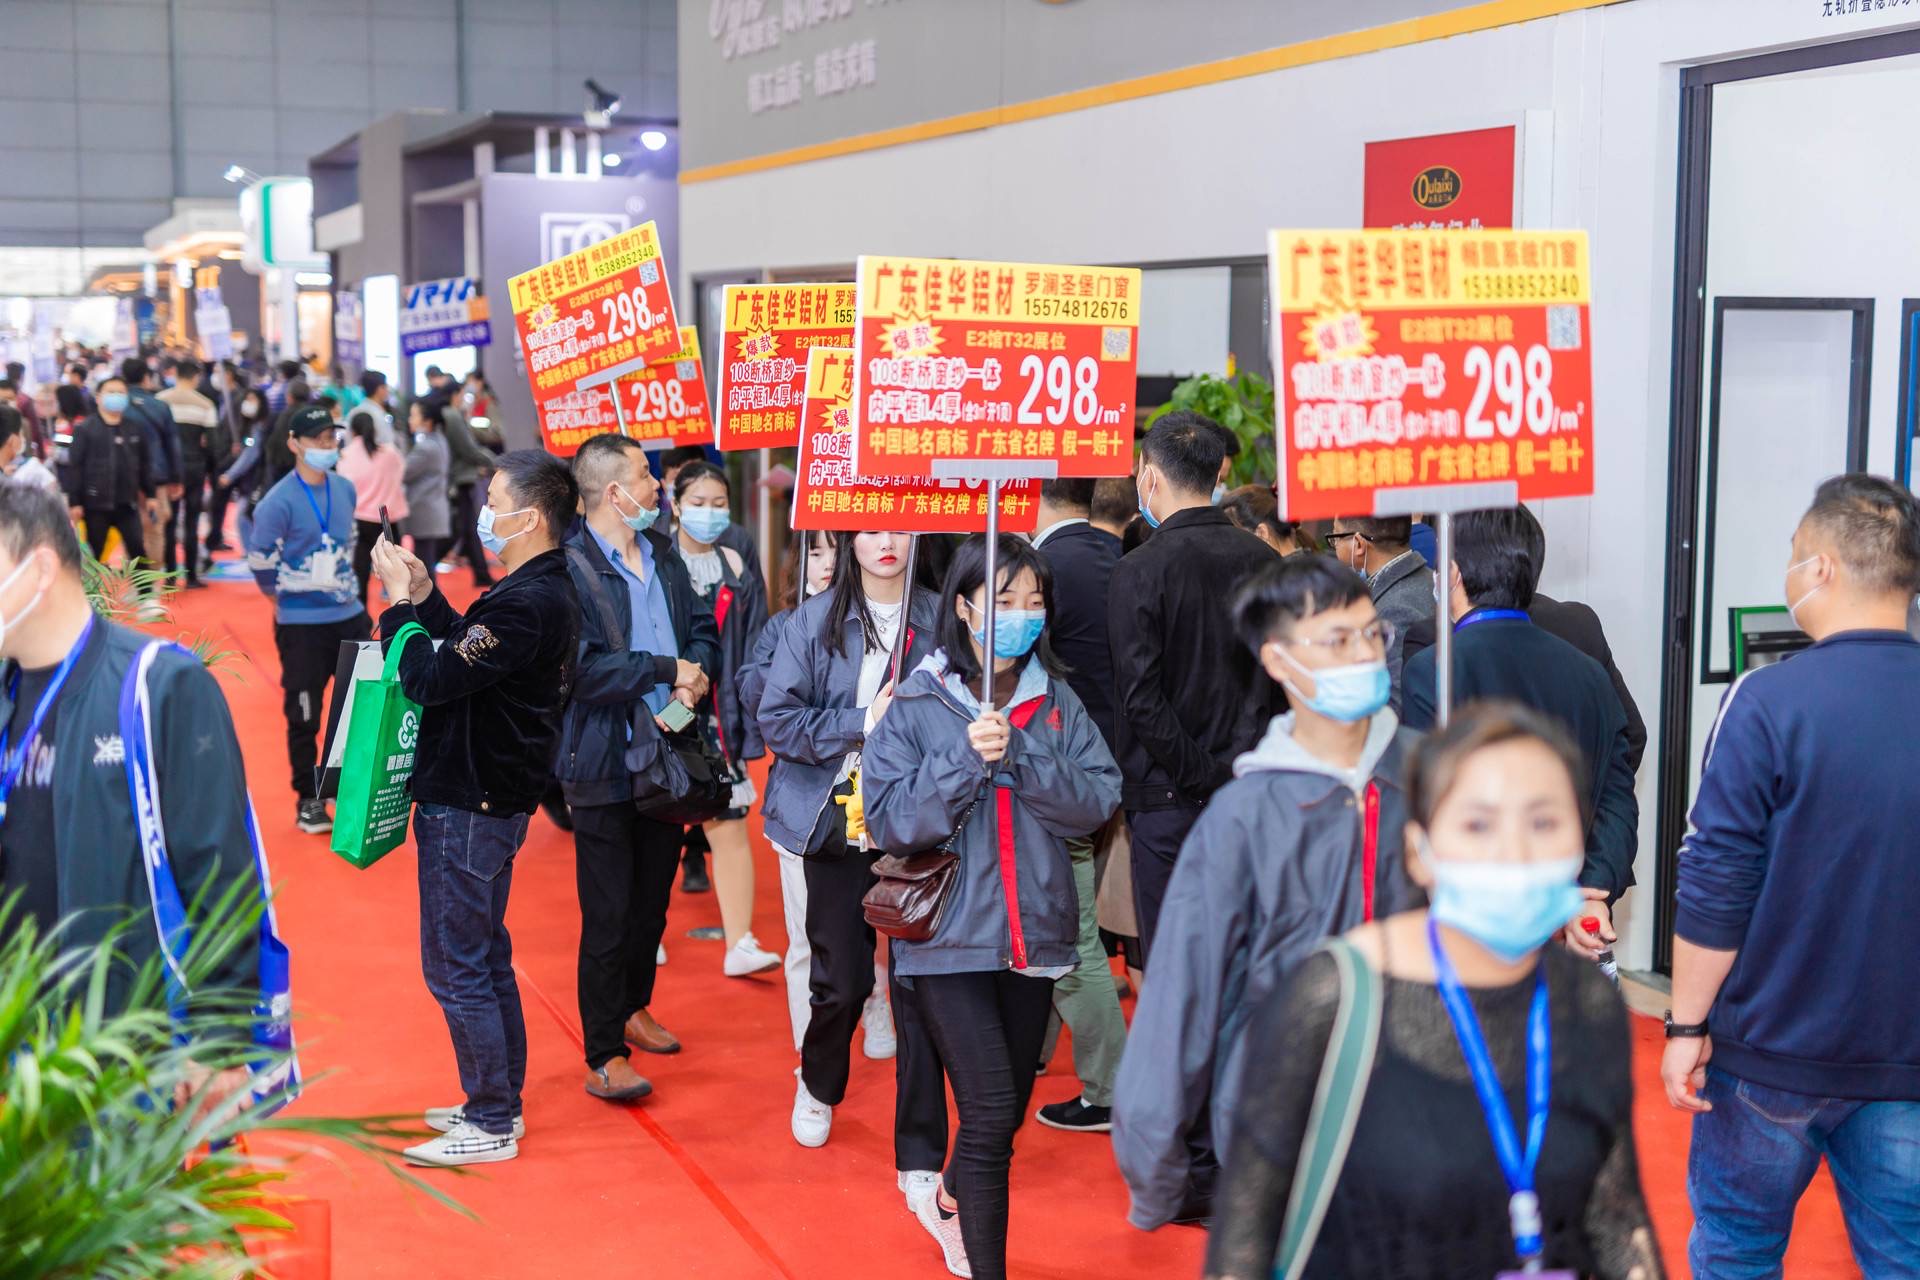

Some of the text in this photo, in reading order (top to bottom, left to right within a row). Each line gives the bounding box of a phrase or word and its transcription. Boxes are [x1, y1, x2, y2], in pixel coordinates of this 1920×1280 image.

[594, 245, 655, 277] 15388952340
[1291, 238, 1450, 300] 广东佳华铝材
[516, 252, 590, 307] 广东佳华铝材
[874, 262, 1015, 316] 广东佳华铝材
[1025, 272, 1130, 298] 罗澜圣堡门窗
[733, 288, 828, 327] 广东佳华铝材
[1024, 298, 1129, 319] 15574812676
[744, 334, 773, 357] 爆款
[966, 330, 1066, 350] E2馆T32展位
[869, 357, 1001, 392] 108断桥窗纱一体
[729, 410, 796, 435] 中国驰名商标
[869, 429, 1123, 457] 中国驰名商标 广东省名牌 假一赔十
[808, 491, 894, 514] 中国驰名商标
[900, 492, 970, 515] 广东省名牌
